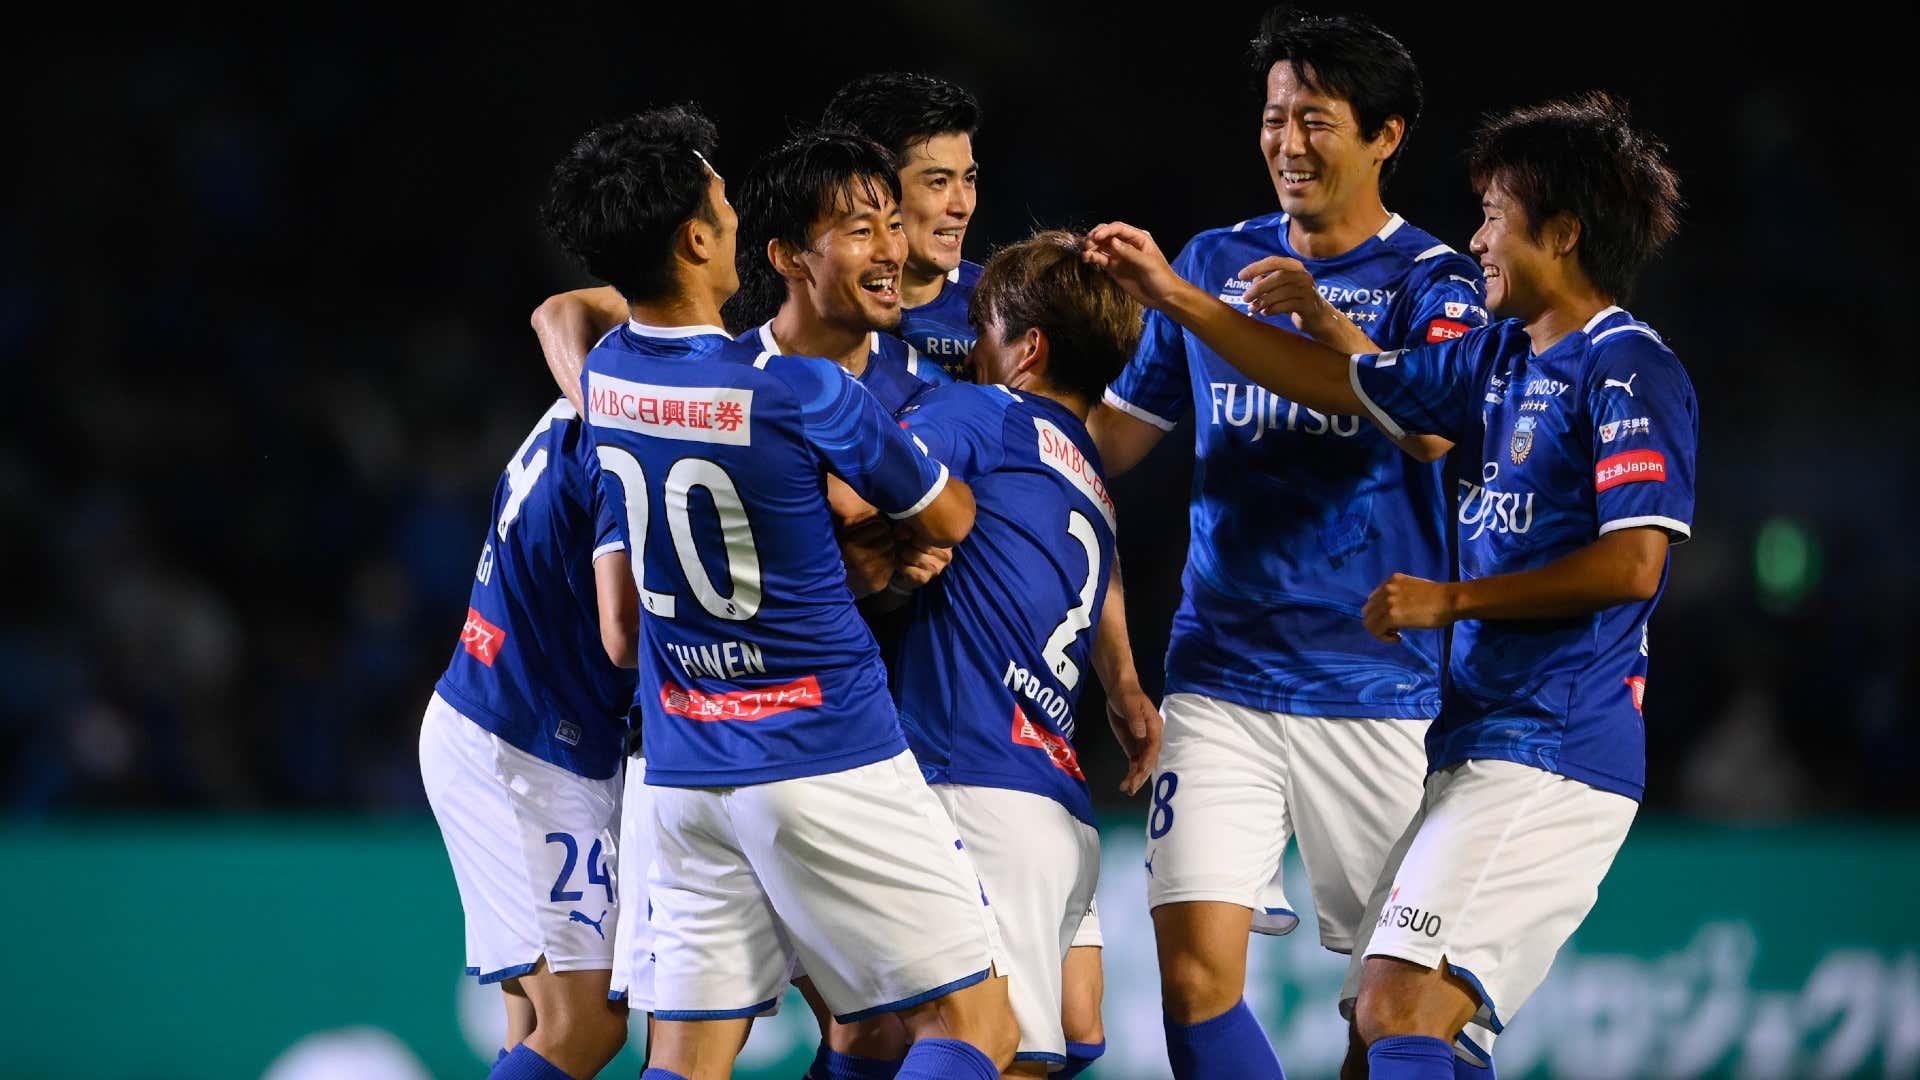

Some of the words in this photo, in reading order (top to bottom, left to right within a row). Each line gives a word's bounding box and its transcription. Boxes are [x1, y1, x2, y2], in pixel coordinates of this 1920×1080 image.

[590, 385, 743, 431] MBC日興証券
[596, 445, 762, 621] 20
[545, 831, 614, 904] 24
